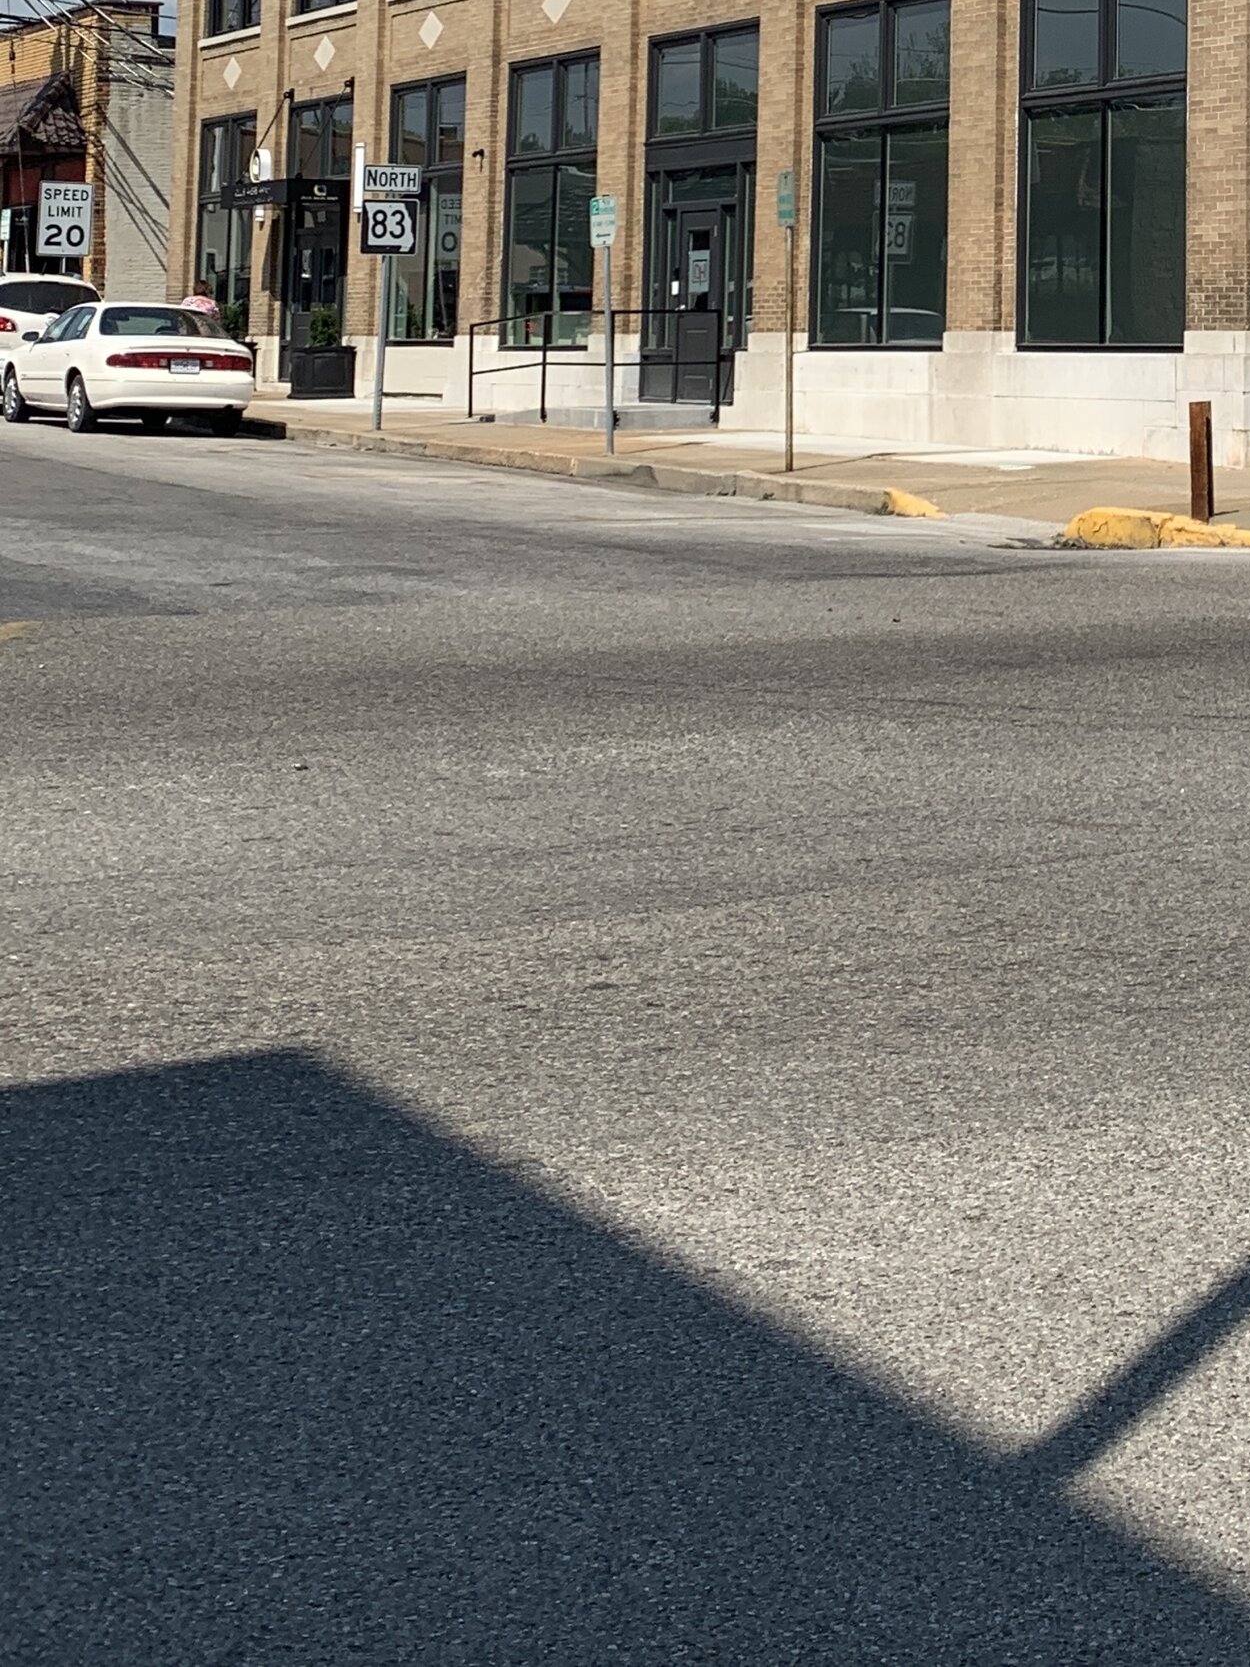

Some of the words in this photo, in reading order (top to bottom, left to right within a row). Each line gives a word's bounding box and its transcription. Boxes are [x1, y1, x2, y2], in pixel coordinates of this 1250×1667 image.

[366, 169, 417, 188] NORTH
[44, 188, 89, 202] SPEED
[48, 205, 83, 218] LIMIT
[371, 209, 406, 239] 83
[44, 224, 85, 247] 20
